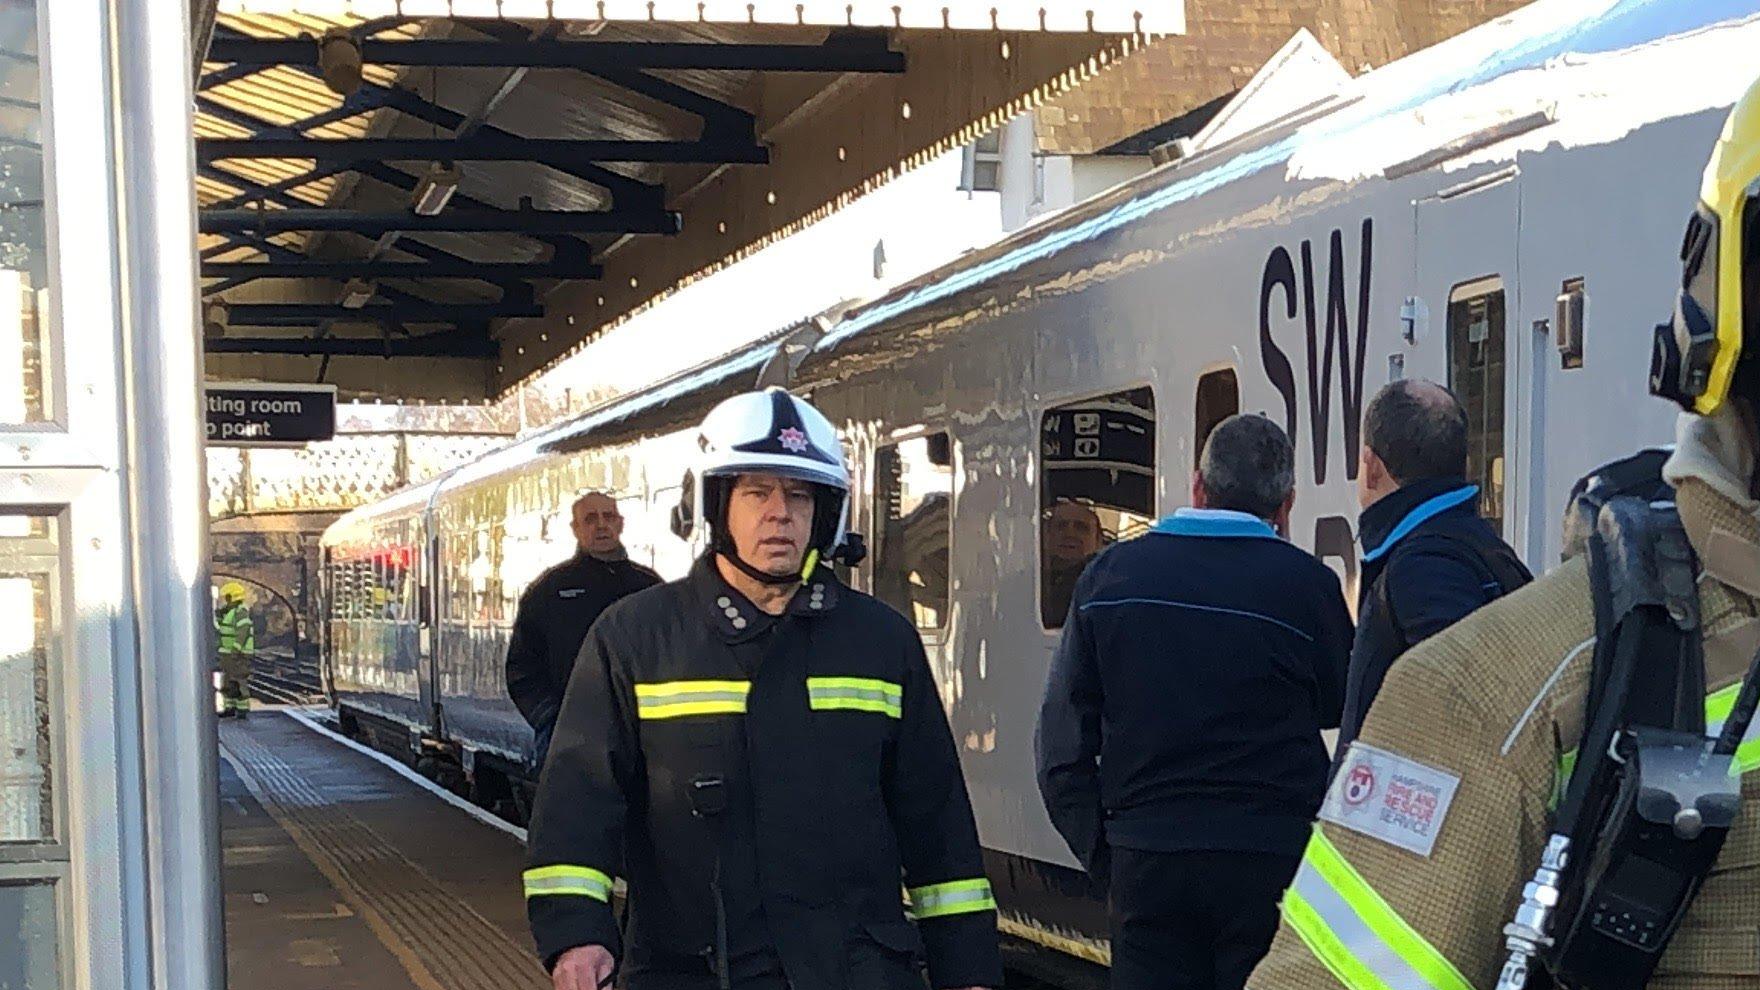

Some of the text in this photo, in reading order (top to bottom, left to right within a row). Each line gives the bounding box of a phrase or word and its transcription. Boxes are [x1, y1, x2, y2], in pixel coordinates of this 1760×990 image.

[1260, 218, 1373, 486] SW
[250, 400, 302, 414] room
[222, 420, 271, 439] point
[1384, 794, 1434, 821] RESCUE
[1387, 783, 1438, 808] FIRE AND
[1380, 808, 1430, 836] SERVICE
